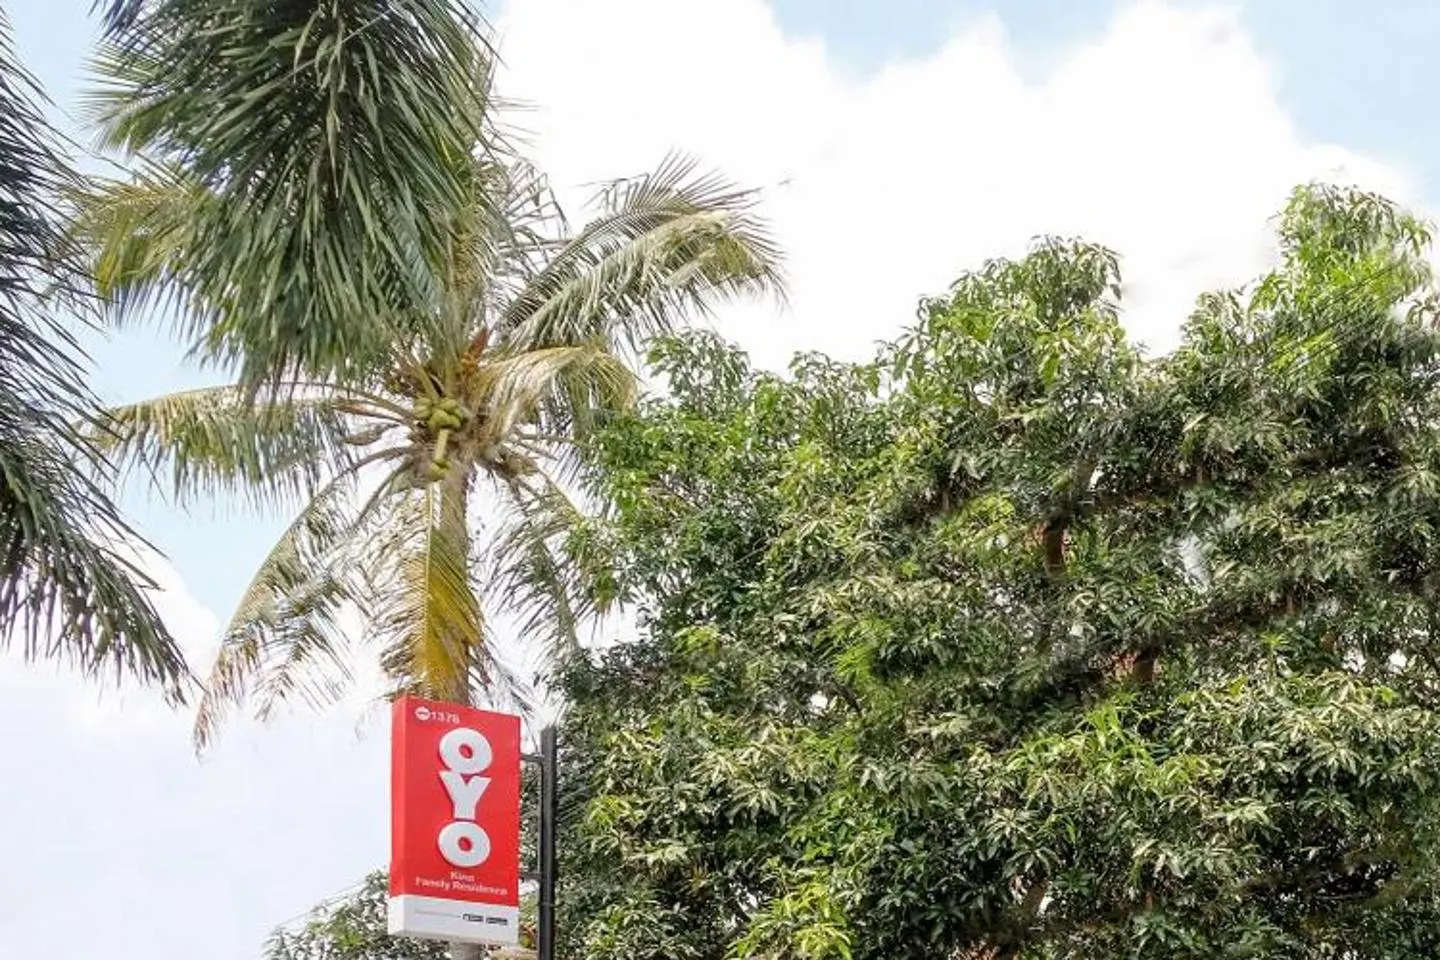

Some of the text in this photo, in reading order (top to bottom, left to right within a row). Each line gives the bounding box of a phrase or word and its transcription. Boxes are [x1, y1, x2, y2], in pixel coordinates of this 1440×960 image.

[438, 727, 493, 867] OYO
[416, 877, 508, 895] Family Residence
